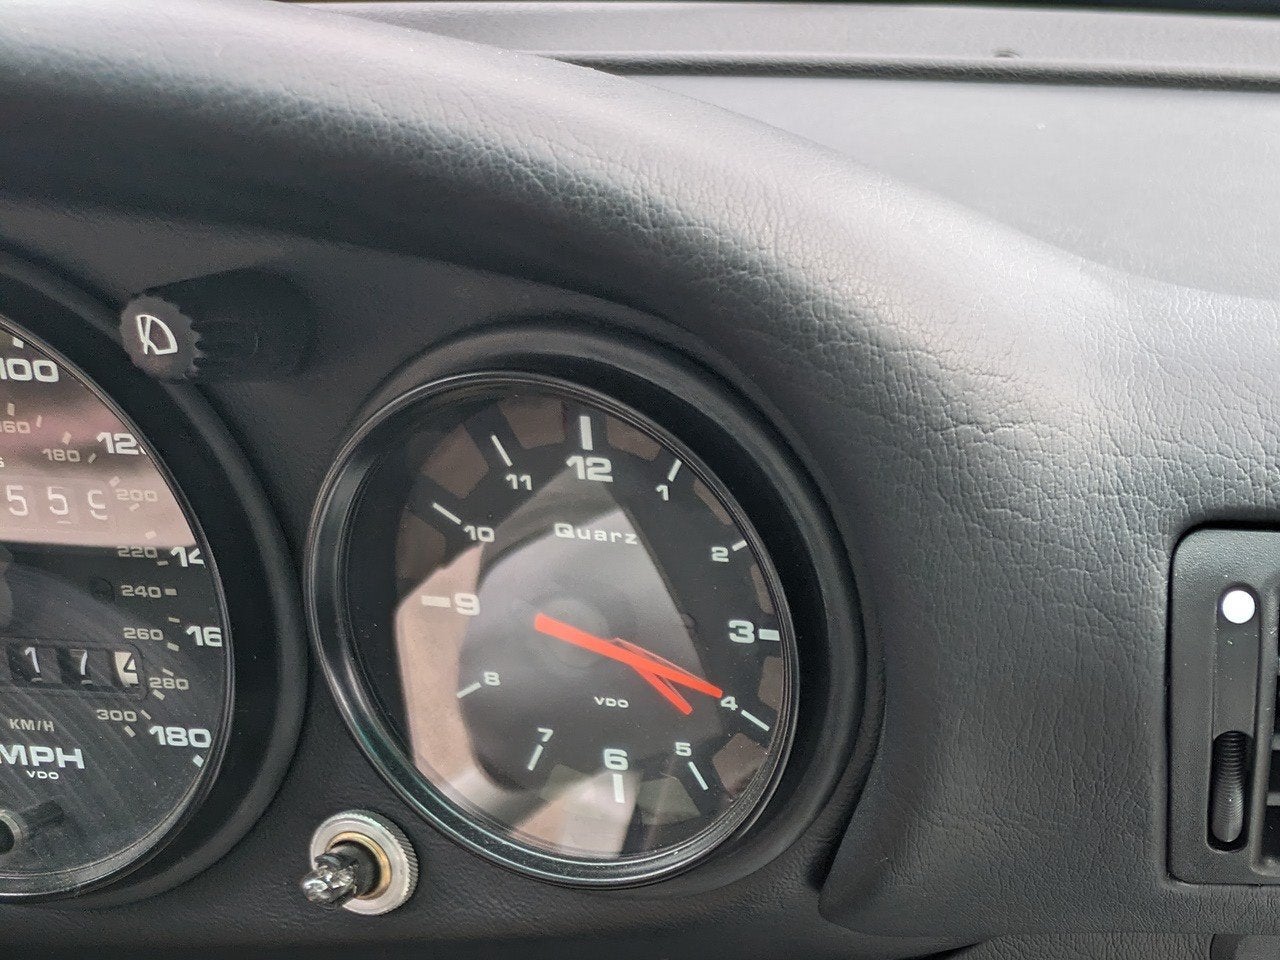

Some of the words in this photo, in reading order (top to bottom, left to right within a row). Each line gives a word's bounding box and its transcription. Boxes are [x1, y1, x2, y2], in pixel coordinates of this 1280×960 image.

[0, 420, 31, 433] 60
[96, 431, 147, 456] 12
[41, 448, 81, 462] 180
[565, 456, 614, 483] 12
[505, 474, 533, 491] 11
[115, 488, 159, 502] 200
[656, 485, 670, 501] 1
[464, 525, 496, 543] 10
[553, 522, 639, 546] Quarz
[117, 545, 158, 559] 220
[711, 546, 730, 563] 2
[120, 584, 162, 599] 240
[453, 592, 481, 617] 9
[123, 627, 164, 641] 260
[728, 619, 756, 645] 3
[148, 677, 190, 691] 280
[483, 671, 501, 687] 8
[593, 696, 629, 709] VDO
[719, 695, 739, 712] 4
[96, 709, 138, 723] 300
[9, 718, 55, 732] KM/H
[149, 725, 213, 749] 180
[537, 727, 554, 743] 7
[0, 743, 85, 770] MPH
[675, 741, 692, 757] 5
[603, 748, 630, 772] 6
[26, 770, 60, 780] VDO
